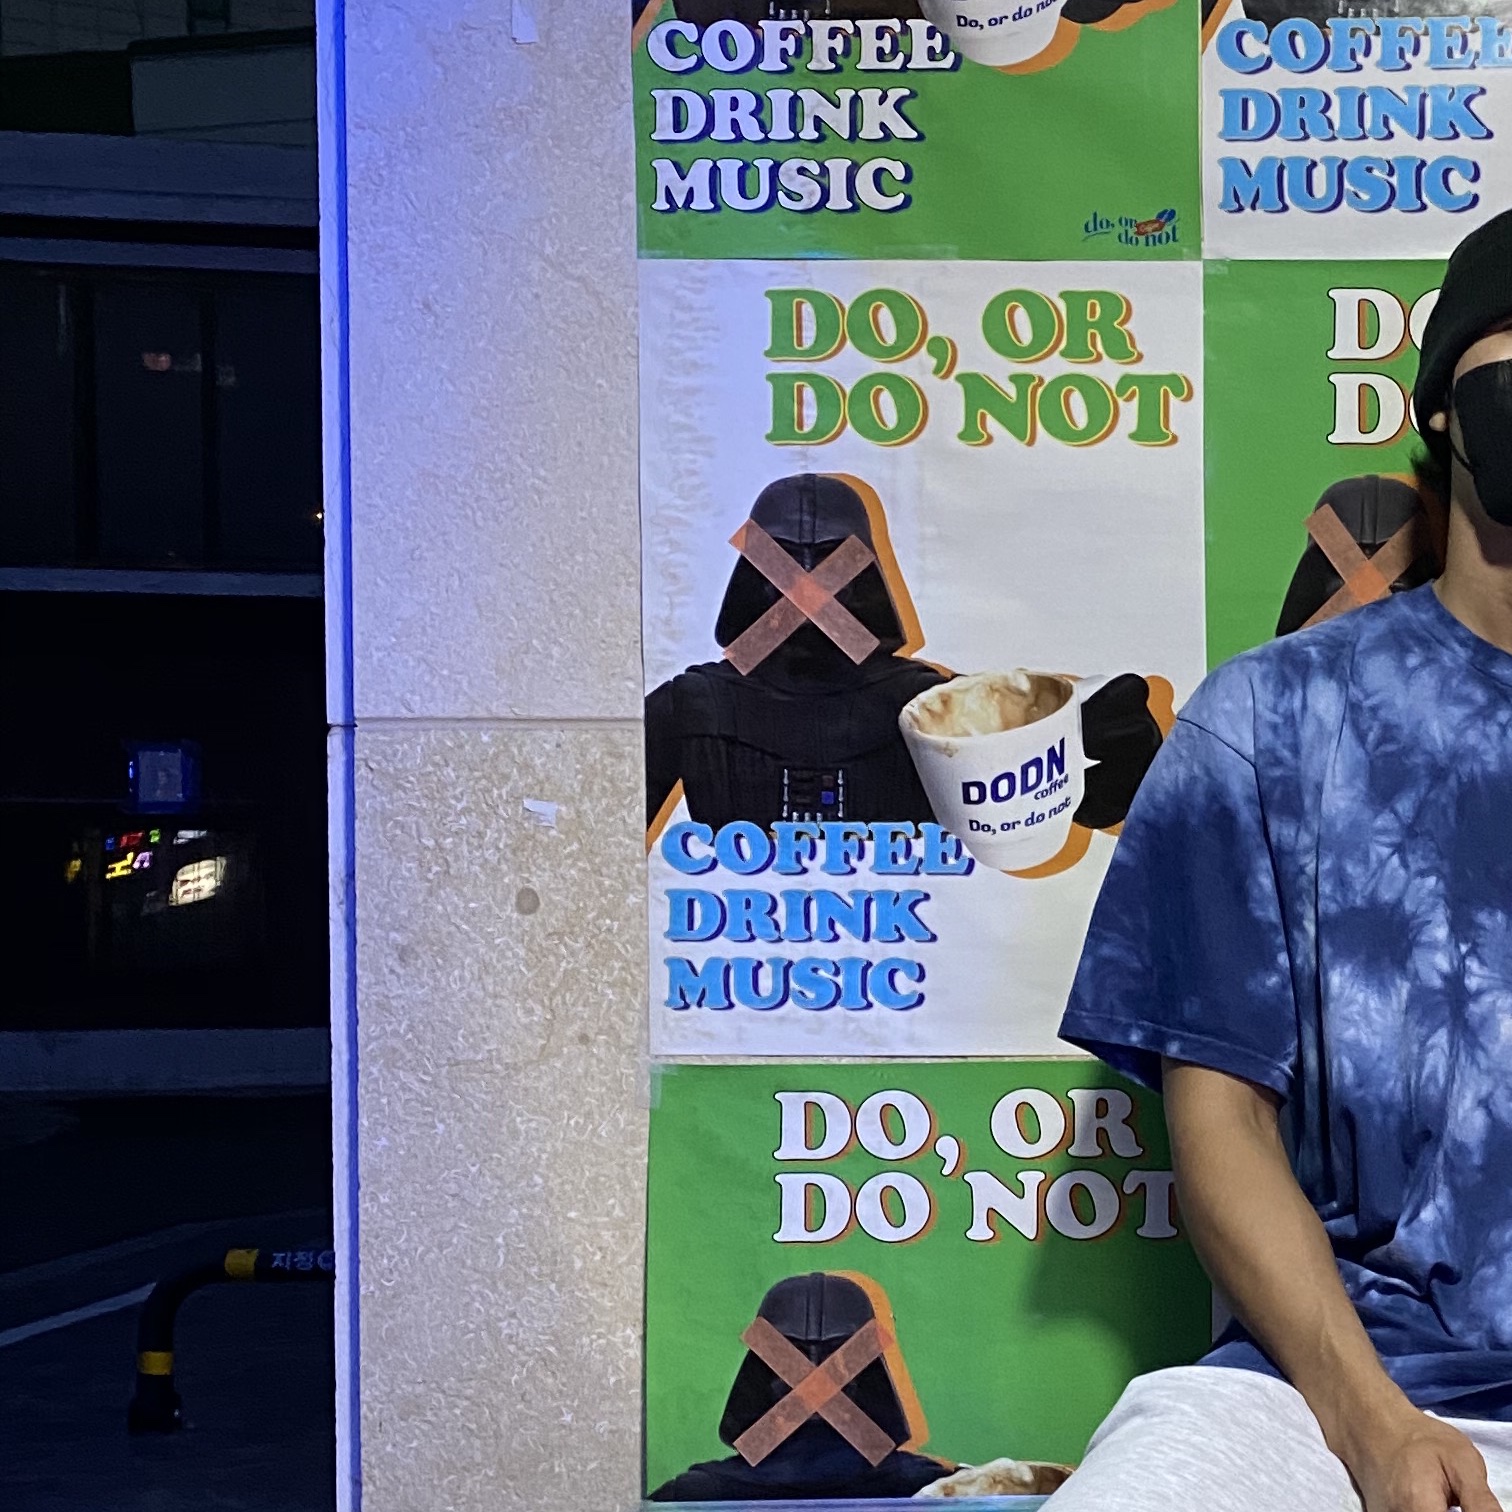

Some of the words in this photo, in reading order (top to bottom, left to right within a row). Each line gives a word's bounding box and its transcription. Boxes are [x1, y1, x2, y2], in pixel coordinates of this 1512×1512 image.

[956, 14, 984, 30] Do,
[988, 15, 1008, 26] or
[1012, 5, 1032, 21] do
[646, 18, 960, 73] COFFEE
[650, 87, 925, 144] DRINK
[1218, 86, 1494, 141] DRINK
[650, 158, 912, 213] MUSIC
[1218, 155, 1480, 213] MUSIC
[1118, 229, 1139, 246] do
[763, 287, 958, 380] DO,
[981, 288, 1144, 365] OR
[764, 372, 929, 448] DO
[955, 372, 1193, 447] NOT
[962, 737, 1065, 805] DODN
[1034, 774, 1069, 800] coffee
[969, 819, 997, 835] Do,
[1000, 821, 1021, 832] or
[1024, 812, 1045, 827] do
[1048, 797, 1071, 818] not
[660, 820, 976, 877] COFFEE
[664, 889, 938, 943] DRINK
[664, 957, 926, 1011] MUSIC
[773, 1088, 963, 1176] DO,
[989, 1088, 1146, 1161] OR
[773, 1170, 934, 1243] DO
[963, 1169, 1181, 1242] NOT
